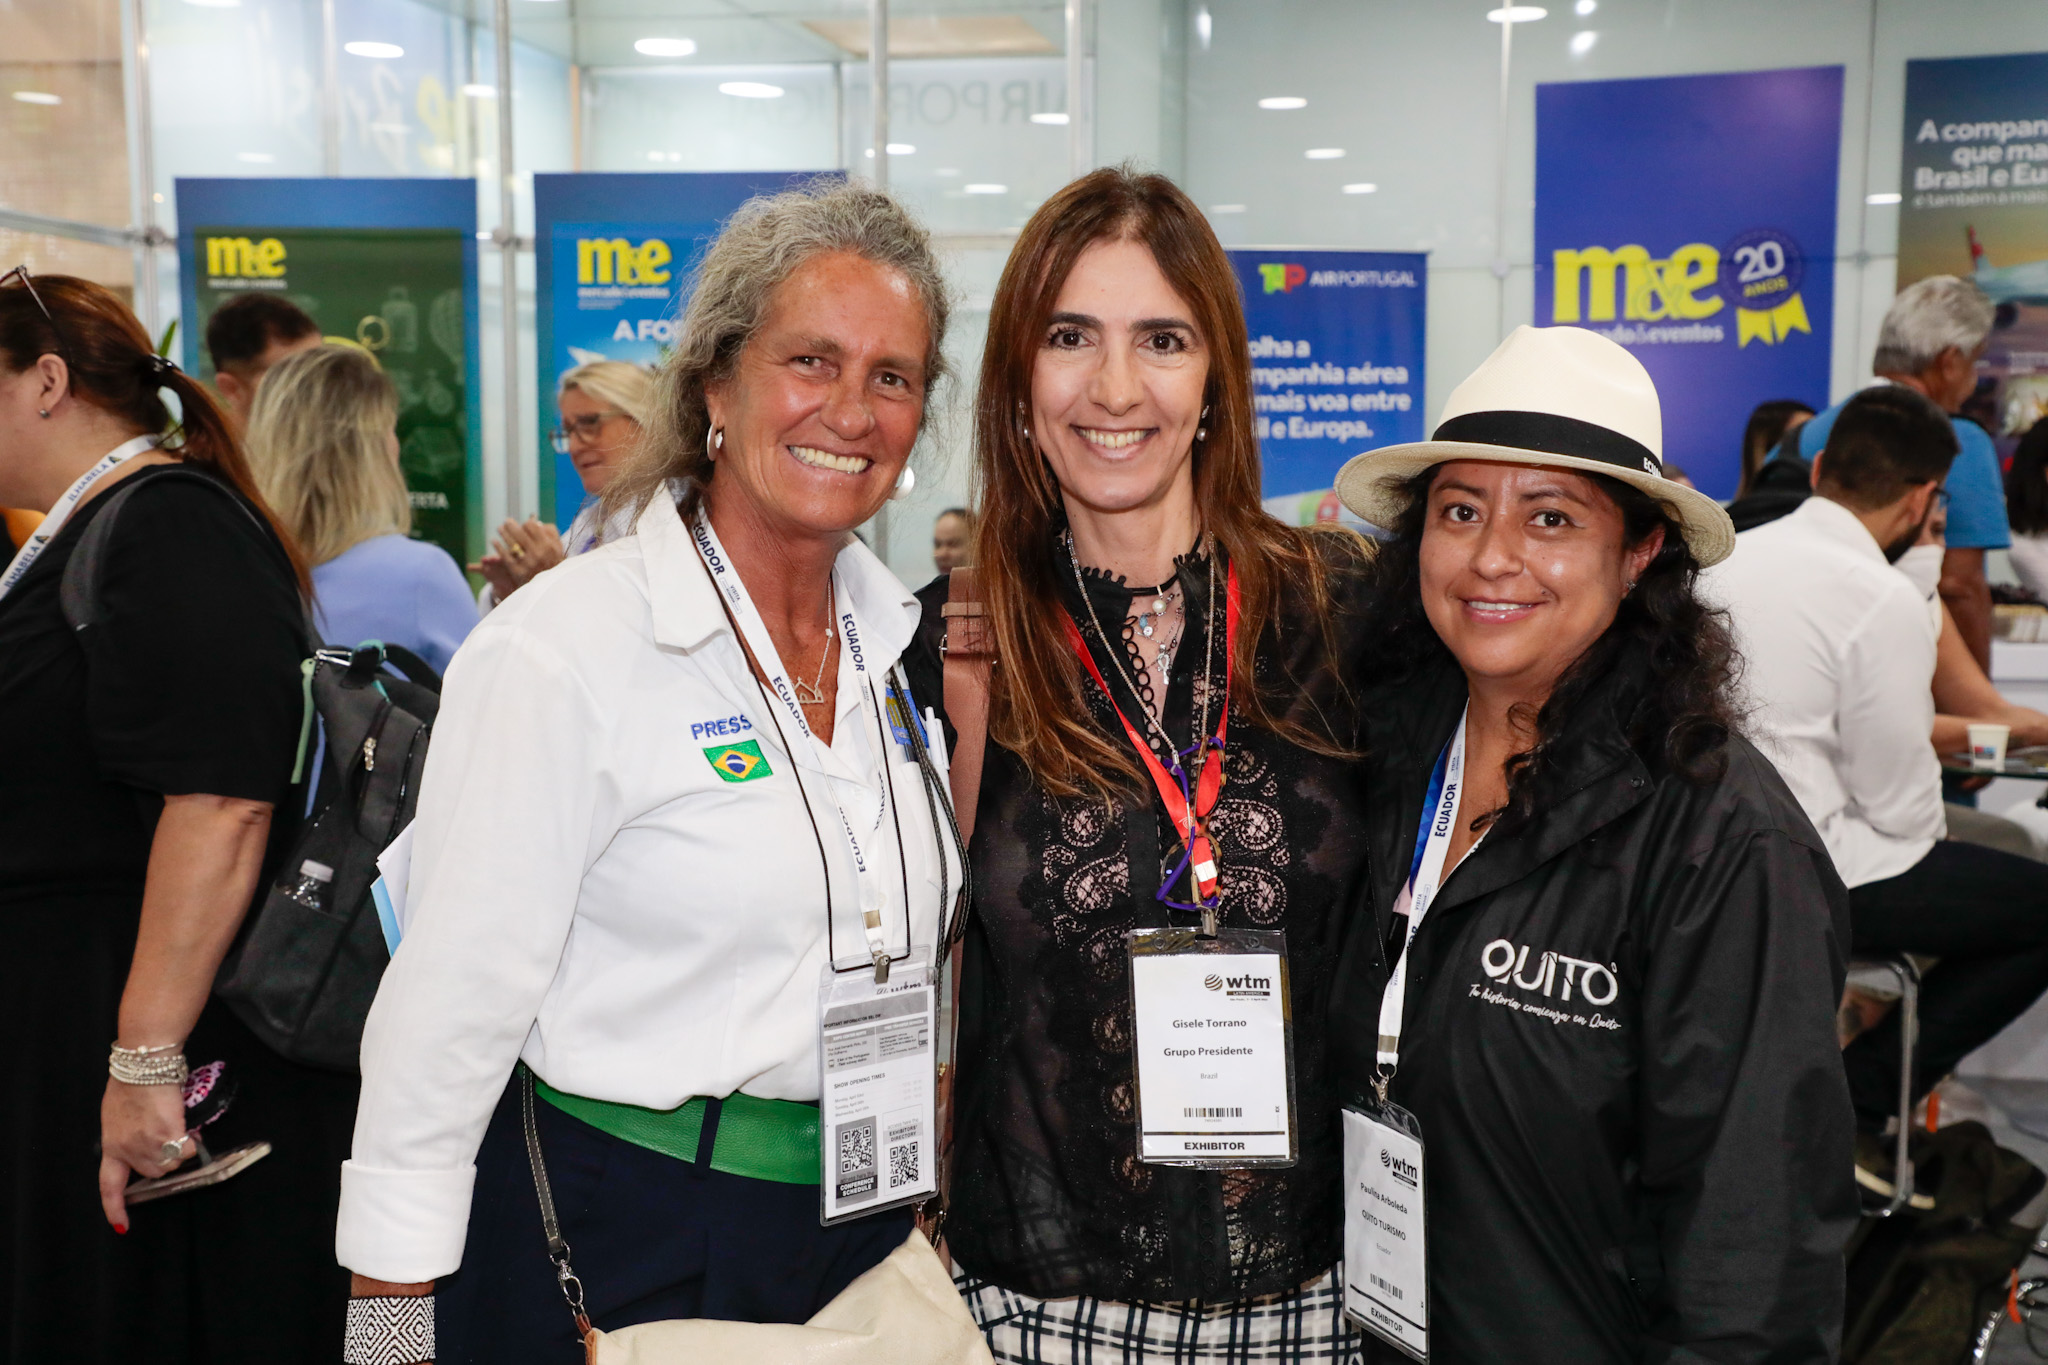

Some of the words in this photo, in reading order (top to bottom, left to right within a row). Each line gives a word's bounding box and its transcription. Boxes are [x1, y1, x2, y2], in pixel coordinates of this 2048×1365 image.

[1916, 119, 1939, 143] A
[1952, 145, 2004, 169] que
[1914, 165, 1989, 190] Brasil
[1990, 169, 2010, 188] e
[1734, 241, 1785, 283] 20
[1258, 263, 1307, 294] TAP
[1553, 243, 1725, 323] m&e
[613, 319, 636, 341] A
[1296, 340, 1311, 358] a
[1347, 361, 1409, 385] aérea
[1253, 389, 1307, 412] mais
[1308, 394, 1349, 412] voa
[1351, 389, 1412, 412] entre
[1271, 421, 1287, 440] e
[1288, 416, 1374, 444] Europa.
[68, 463, 109, 502] ILHABELA
[3, 545, 40, 588] ILHABELA
[841, 612, 866, 672] ECUADOR
[772, 675, 811, 739] ECUADOR
[690, 713, 753, 741] PRESS
[1434, 782, 1458, 838] ECUADOR
[839, 806, 867, 873] ECUADOR
[1226, 974, 1271, 989] wtm
[1481, 938, 1619, 1007] QUITO
[1481, 986, 1522, 1011] historia
[1522, 1002, 1571, 1025] comienza
[1588, 1013, 1622, 1031] Quito
[1172, 1019, 1204, 1028] Gisele
[1206, 1019, 1247, 1028] Torrano
[1164, 1047, 1196, 1059] Grupo
[1198, 1046, 1253, 1056] Presidente
[834, 1081, 849, 1089] SHOW
[850, 1076, 870, 1086] OPENING
[1200, 1072, 1218, 1080] Brazil
[1184, 1142, 1245, 1151] EXHIBITOR
[1392, 1156, 1418, 1180] wtm
[840, 1176, 875, 1191] CONFERENCE
[842, 1183, 872, 1197] SCHEDULE
[1360, 1182, 1380, 1200] Paulina
[1381, 1194, 1408, 1215] Arboleda
[1362, 1209, 1378, 1226] QUITO
[1379, 1219, 1407, 1241] TURISMO
[1370, 1307, 1403, 1334] EXHIBITOR
